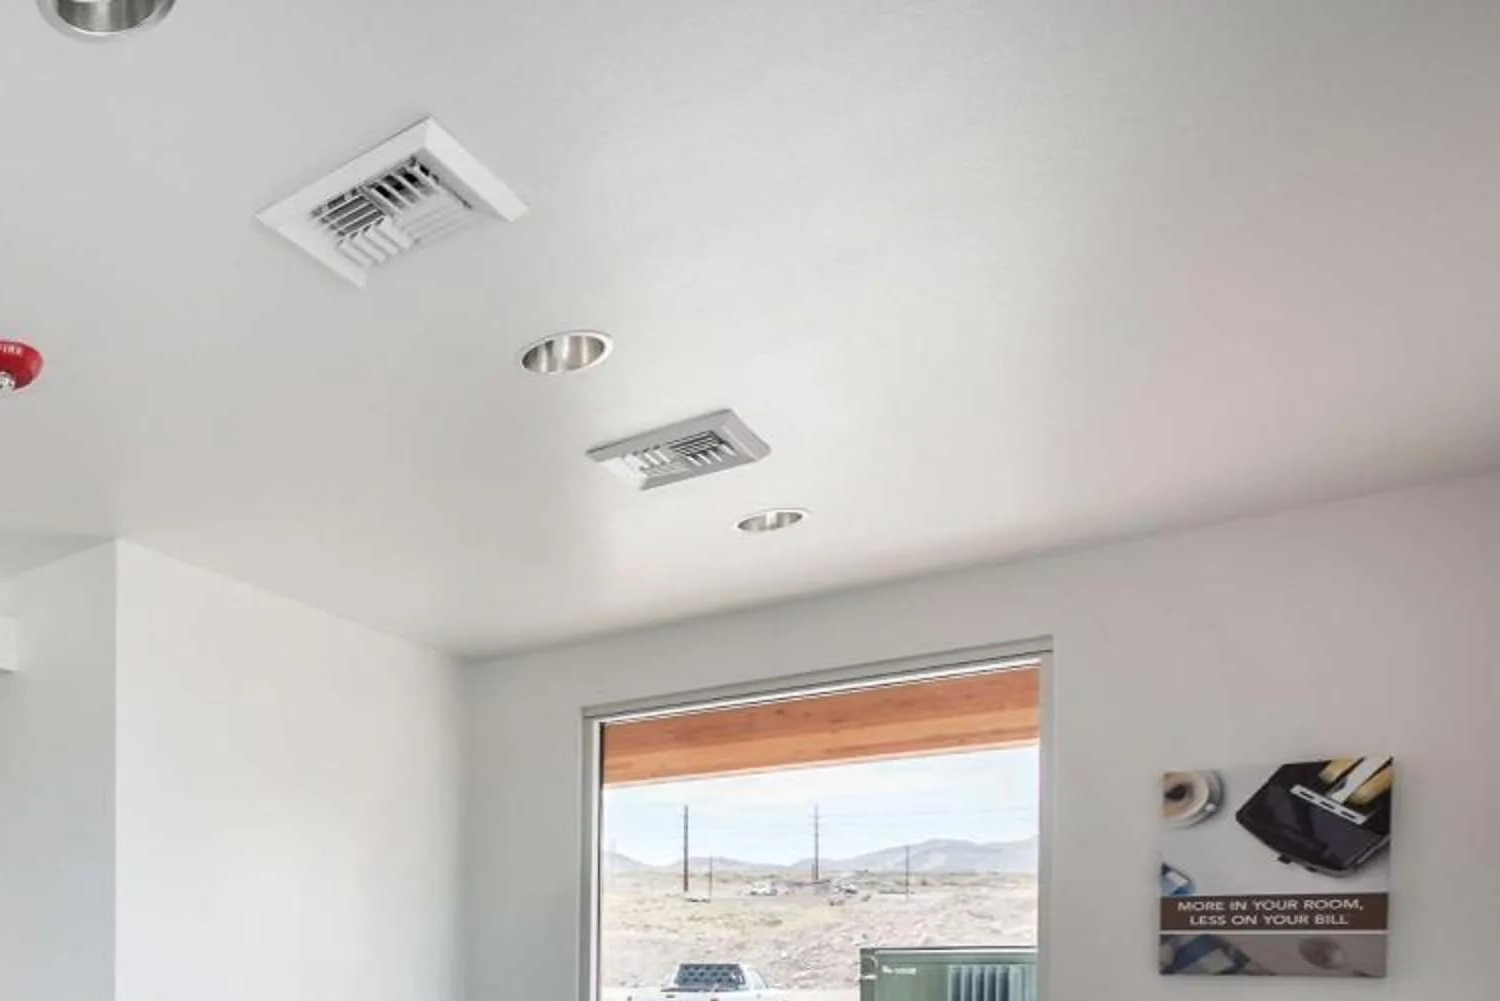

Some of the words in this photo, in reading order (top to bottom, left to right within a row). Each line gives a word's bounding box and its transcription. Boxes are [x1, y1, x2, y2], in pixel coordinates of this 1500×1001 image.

[1177, 901, 1225, 912] MORE
[1230, 900, 1247, 911] IN
[1253, 900, 1298, 911] YOUR
[1304, 899, 1364, 911] ROOM,
[1189, 915, 1227, 926] LESS
[1231, 915, 1258, 926] ON
[1263, 915, 1309, 926] YOUR
[1314, 914, 1349, 925] BILL
